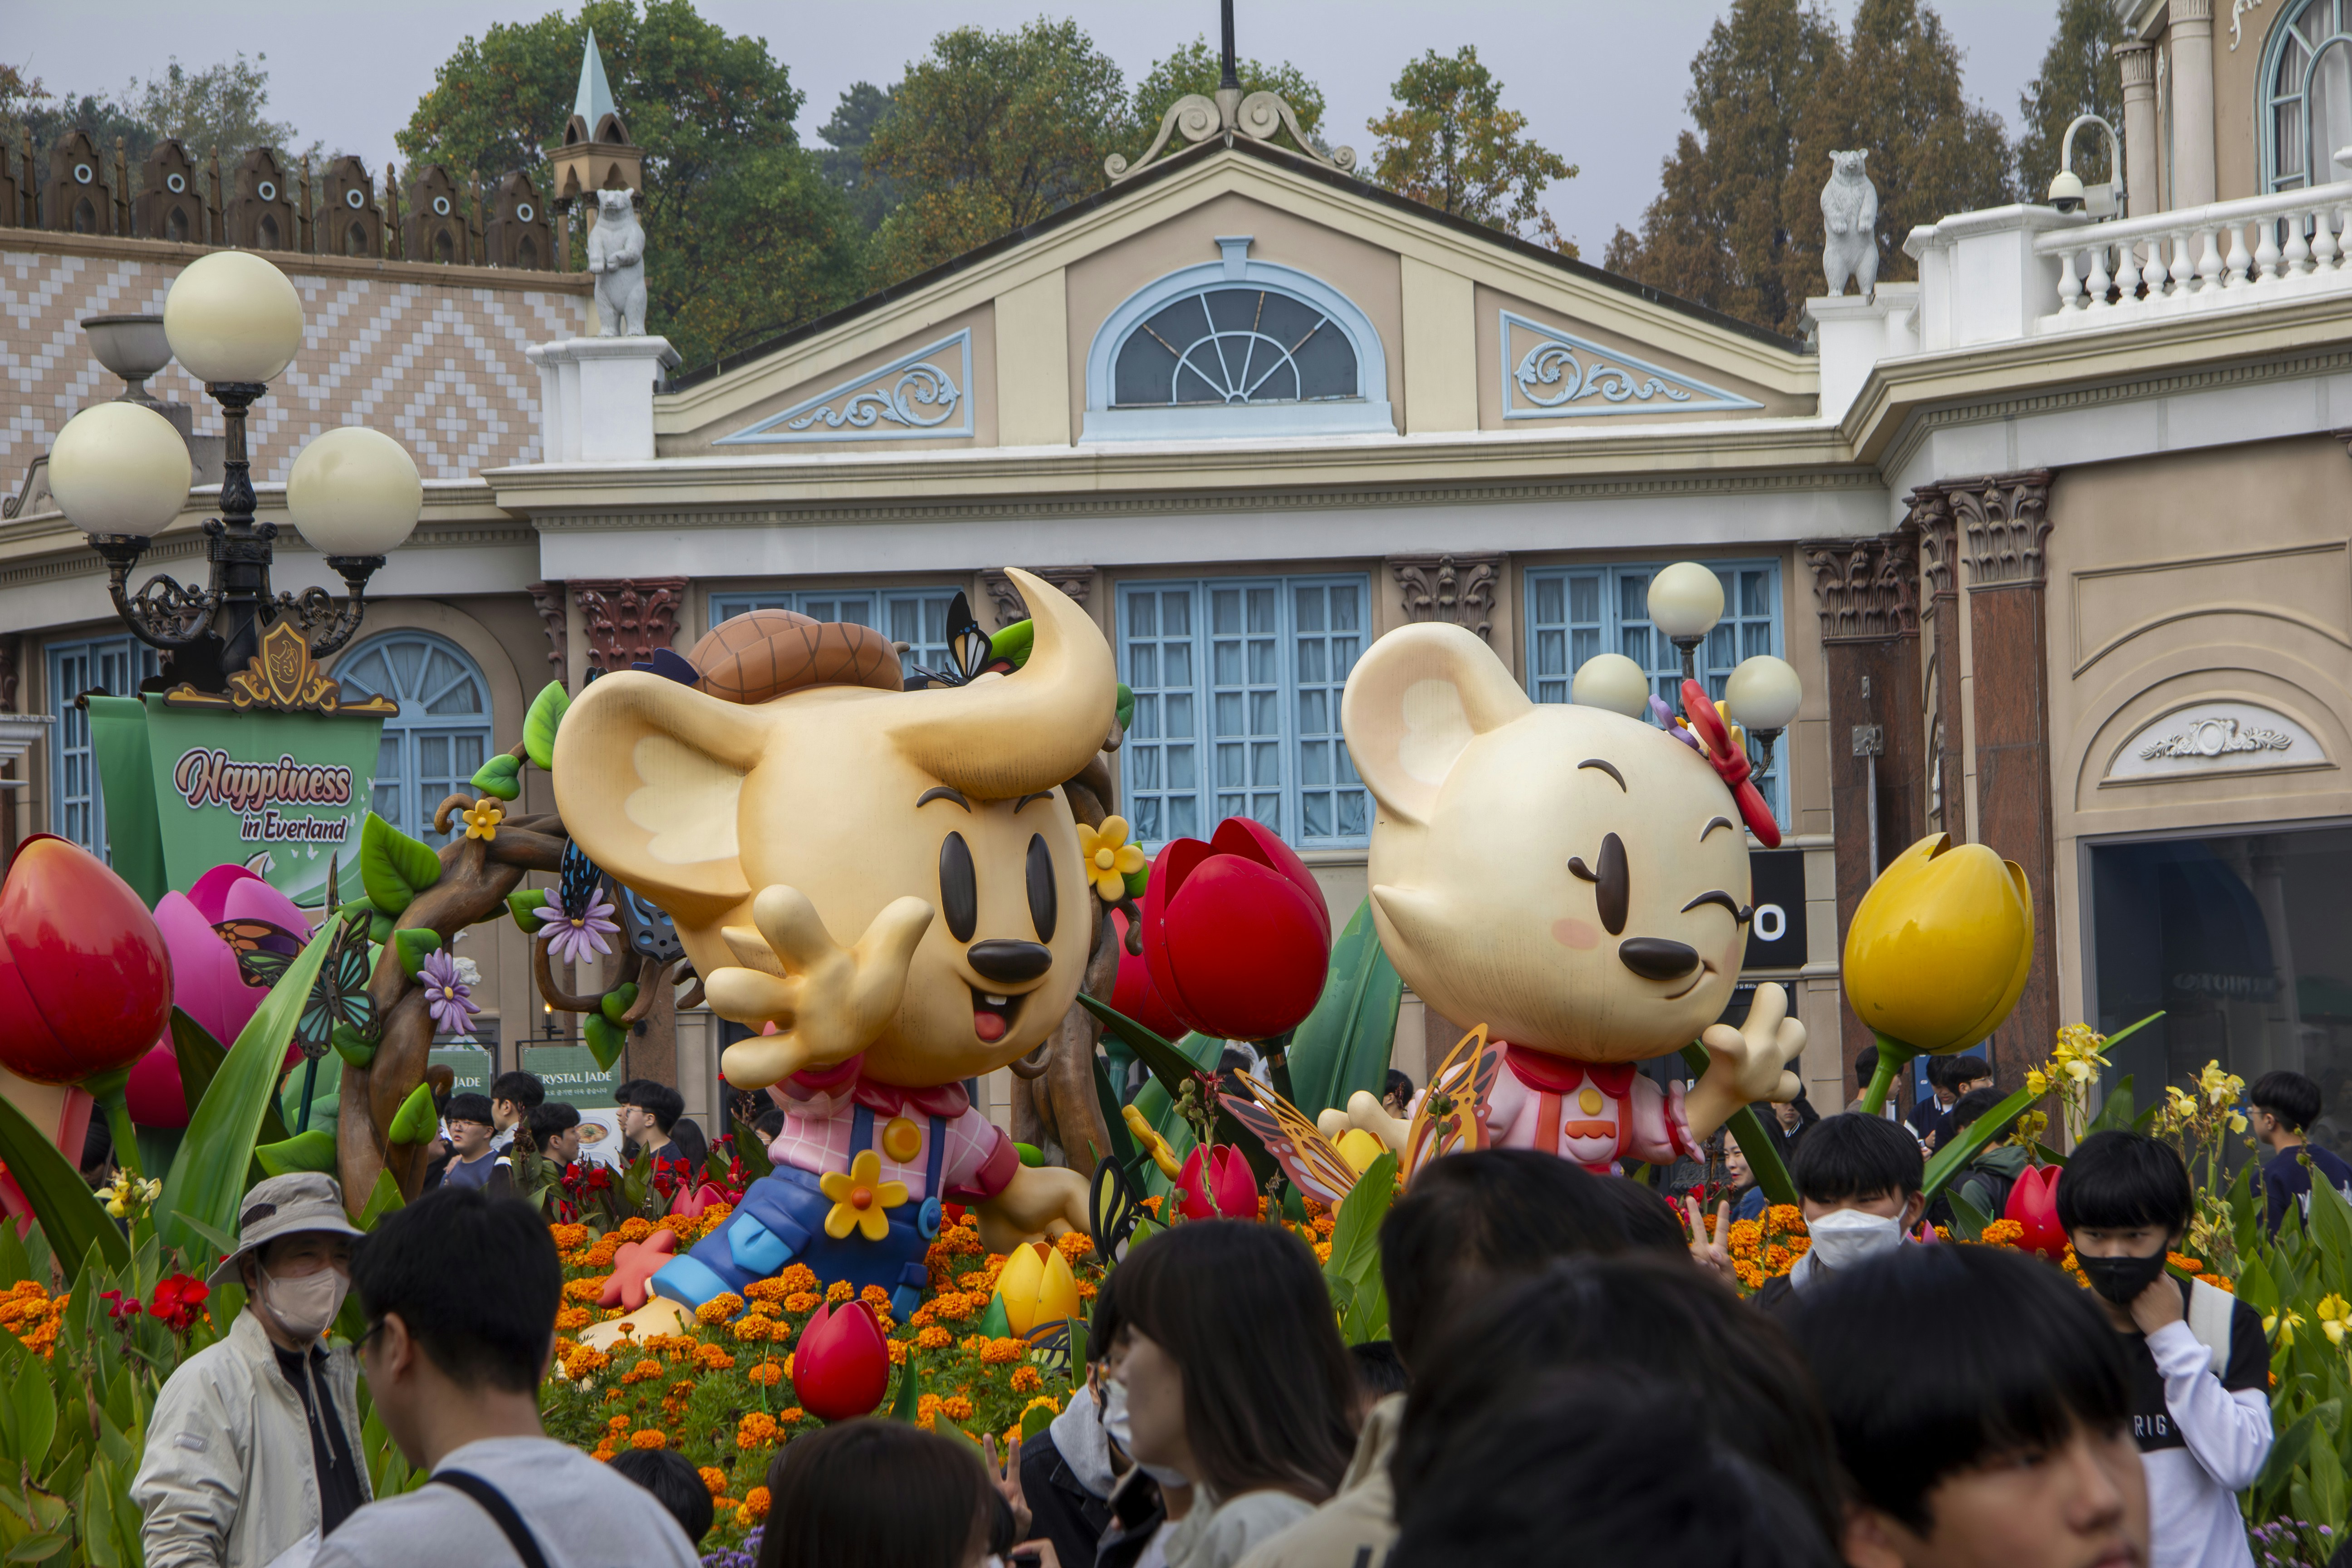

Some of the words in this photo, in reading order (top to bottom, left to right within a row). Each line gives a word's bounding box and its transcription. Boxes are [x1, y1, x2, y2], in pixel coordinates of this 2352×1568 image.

[175, 748, 352, 813] Happiness
[241, 813, 260, 840] in
[264, 811, 347, 842] Everland
[454, 1076, 481, 1089] JADE
[585, 1071, 612, 1083] JADE
[586, 1087, 608, 1095] 좋습니다
[2134, 1414, 2177, 1438] RIG
